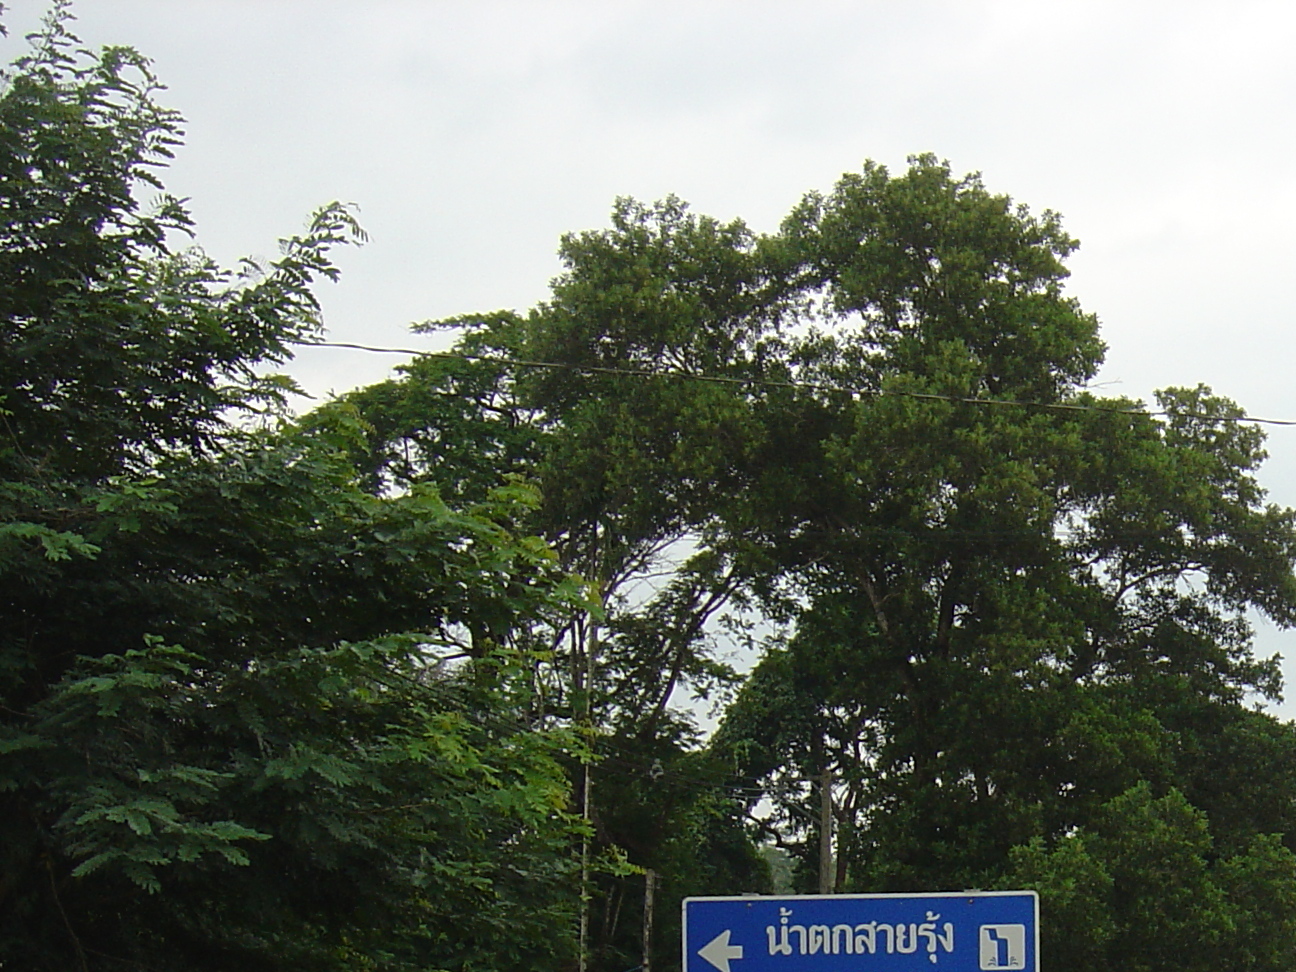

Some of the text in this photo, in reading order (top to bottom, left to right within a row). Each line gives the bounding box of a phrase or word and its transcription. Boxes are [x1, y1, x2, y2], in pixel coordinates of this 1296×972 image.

[766, 907, 954, 964] น้ำตกสายรุ้ง
